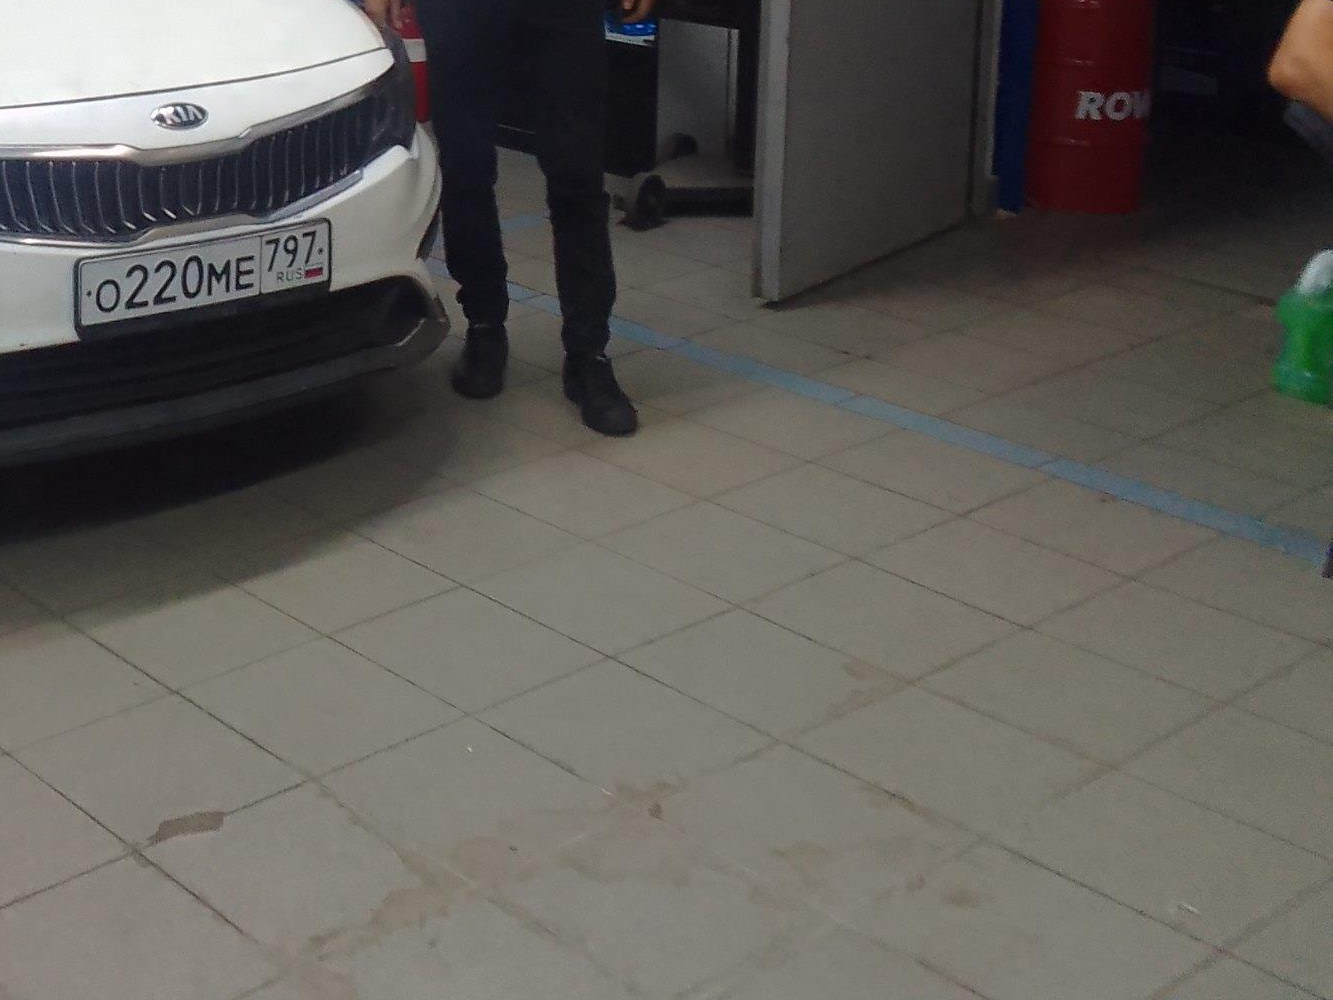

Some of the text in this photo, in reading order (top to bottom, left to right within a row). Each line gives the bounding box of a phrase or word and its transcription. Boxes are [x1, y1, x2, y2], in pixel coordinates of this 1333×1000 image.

[154, 103, 206, 128] KIA
[265, 231, 317, 273] 797
[276, 268, 304, 283] RUS
